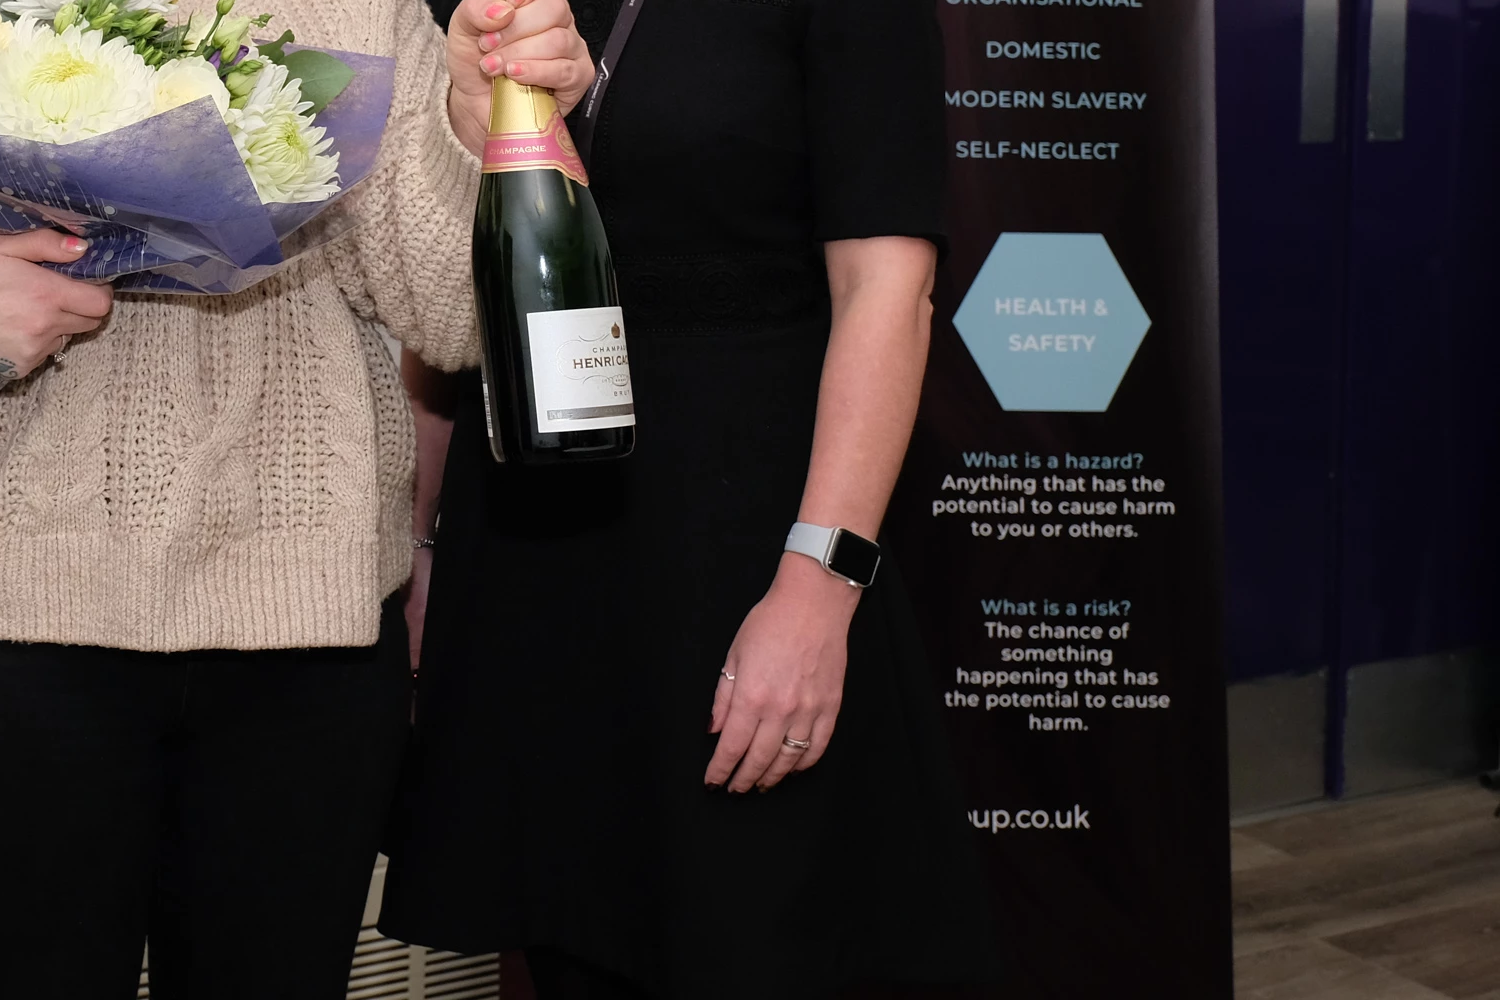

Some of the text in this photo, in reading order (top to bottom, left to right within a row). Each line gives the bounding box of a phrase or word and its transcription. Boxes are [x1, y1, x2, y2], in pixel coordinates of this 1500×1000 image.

[985, 40, 1101, 60] DOMESTIC
[944, 89, 1147, 110] MODERN SLAVERY
[489, 144, 547, 155] CHAMPAGNE
[955, 140, 1120, 160] SELF-NEGLECT
[994, 297, 1109, 317] HEALTH &
[1007, 334, 1096, 353] SAFETY
[573, 355, 615, 369] HENRI
[962, 451, 1144, 470] What is a hazard?
[941, 473, 1166, 496] Anything that has the
[932, 496, 1176, 517] potential to cause harm
[971, 520, 1139, 541] to you or others.
[980, 599, 1132, 617] What is a risk?
[984, 621, 1130, 640] The chance of
[1000, 645, 1114, 666] something
[956, 667, 1159, 689] happening that has
[944, 690, 1171, 711] the potential to cause
[1028, 713, 1089, 731] harm.
[967, 803, 1091, 834] up.co.uk
